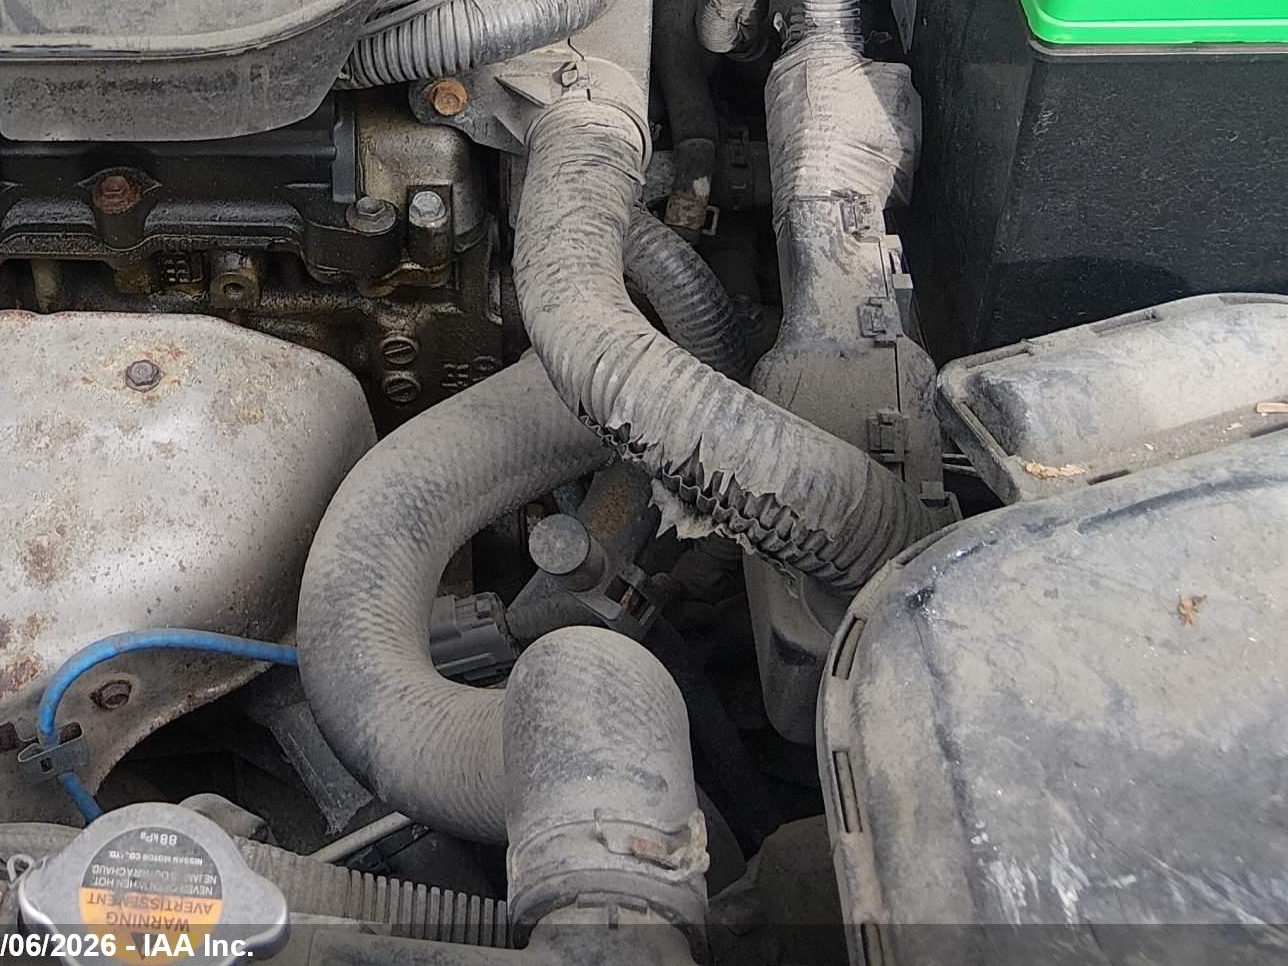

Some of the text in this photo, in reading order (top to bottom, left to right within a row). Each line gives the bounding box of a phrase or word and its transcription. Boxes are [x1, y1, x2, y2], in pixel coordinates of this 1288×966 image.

[140, 832, 177, 846] 88 kPa
[142, 854, 172, 863] MOTOR
[172, 856, 202, 866] NISSAN
[204, 874, 217, 884] NE
[106, 911, 190, 933] WARNING
